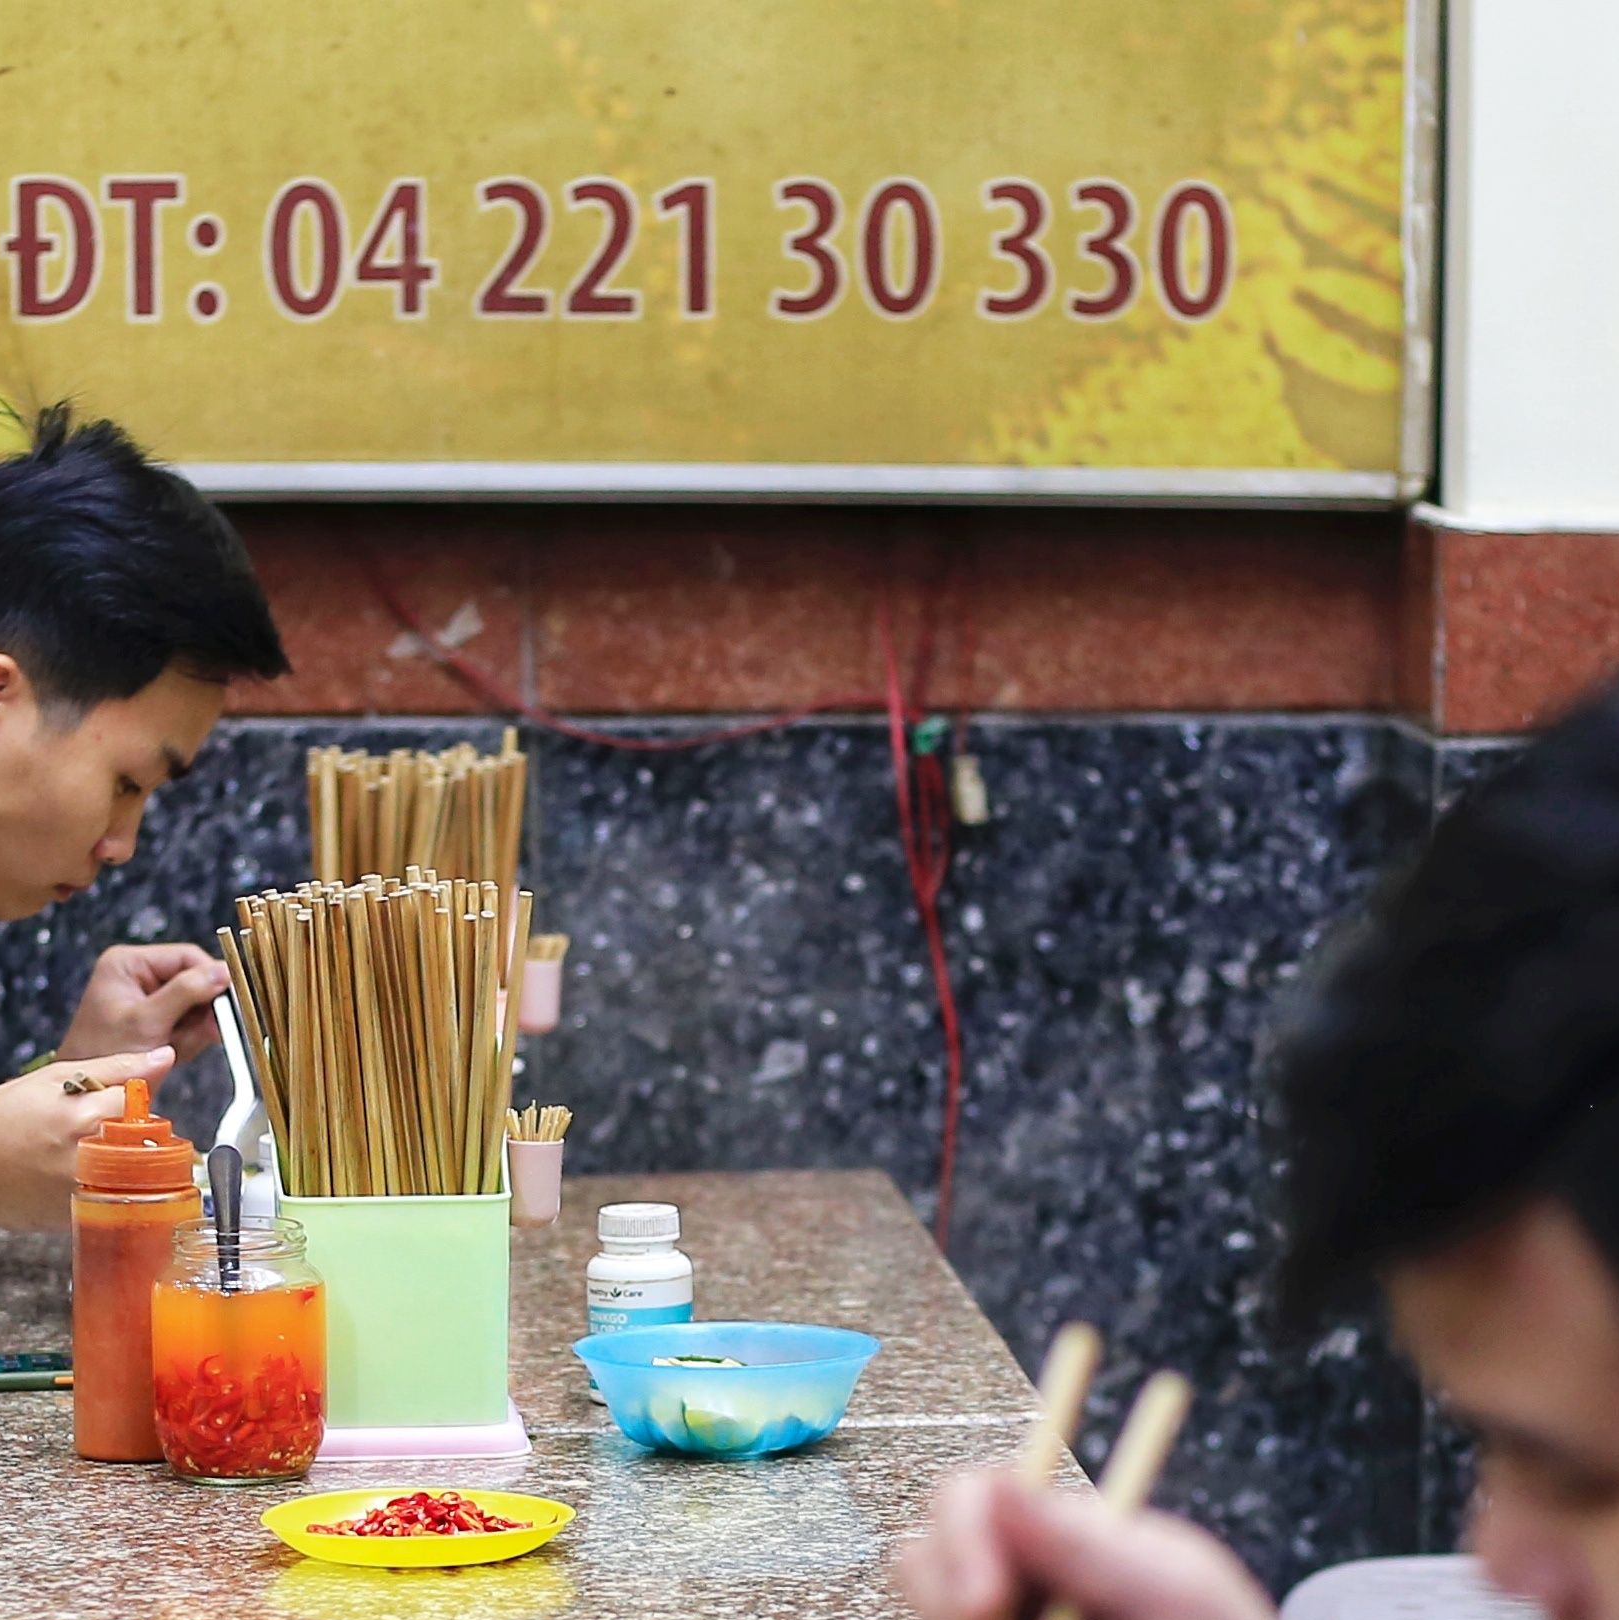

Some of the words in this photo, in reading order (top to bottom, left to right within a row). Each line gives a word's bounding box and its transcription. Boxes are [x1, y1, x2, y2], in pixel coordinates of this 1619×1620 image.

[6, 180, 222, 317] ĐT:
[271, 183, 432, 316] 04
[481, 182, 713, 314] 221
[777, 182, 933, 315] 30
[986, 183, 1229, 318] 330
[622, 1289, 644, 1298] Care
